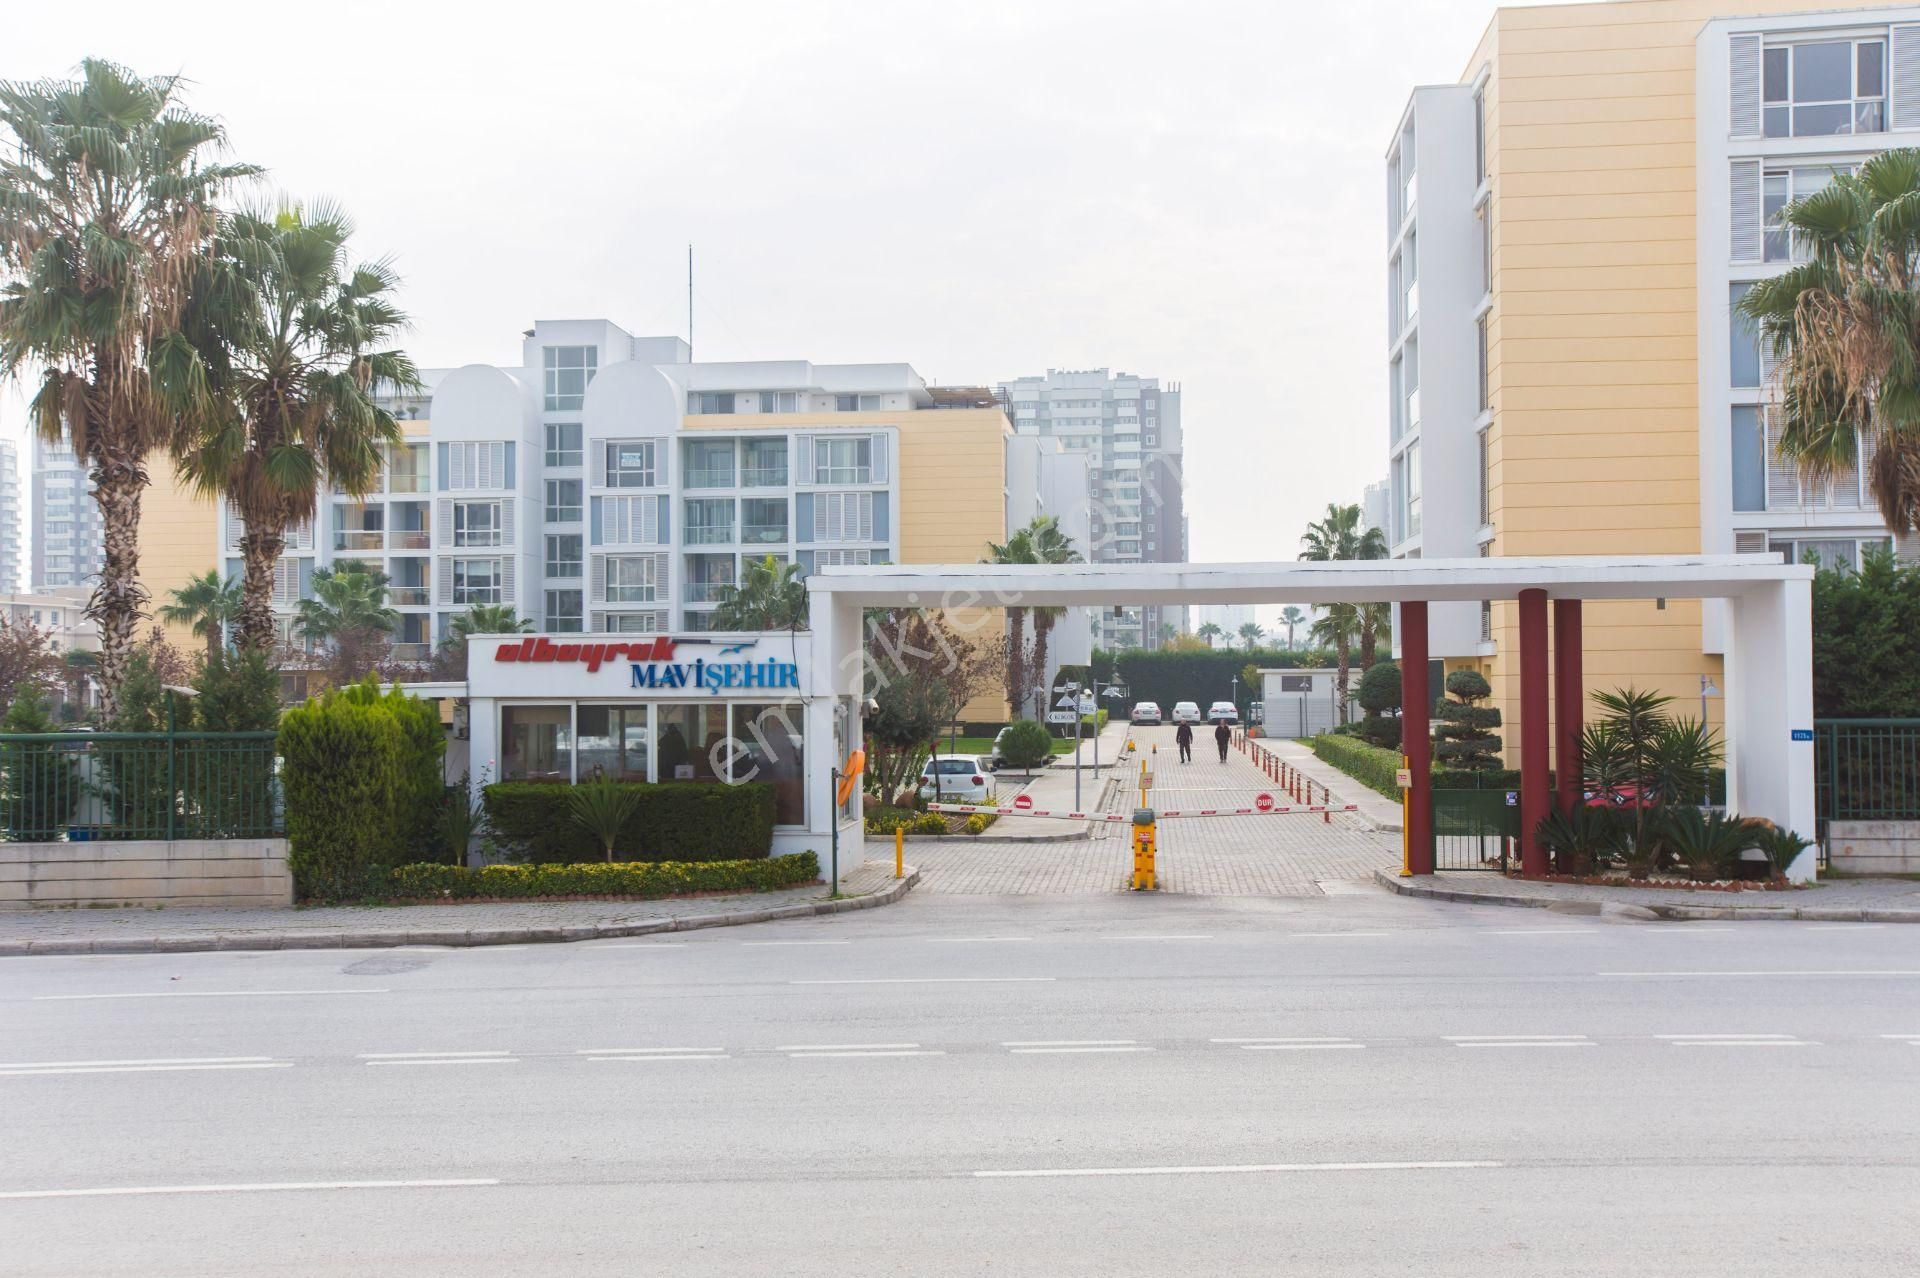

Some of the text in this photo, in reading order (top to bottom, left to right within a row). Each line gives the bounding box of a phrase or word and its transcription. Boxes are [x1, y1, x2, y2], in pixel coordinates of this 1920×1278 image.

[495, 636, 679, 673] albayrak
[630, 657, 798, 694] MAVİŞEHİR
[1257, 799, 1272, 807] DUR
